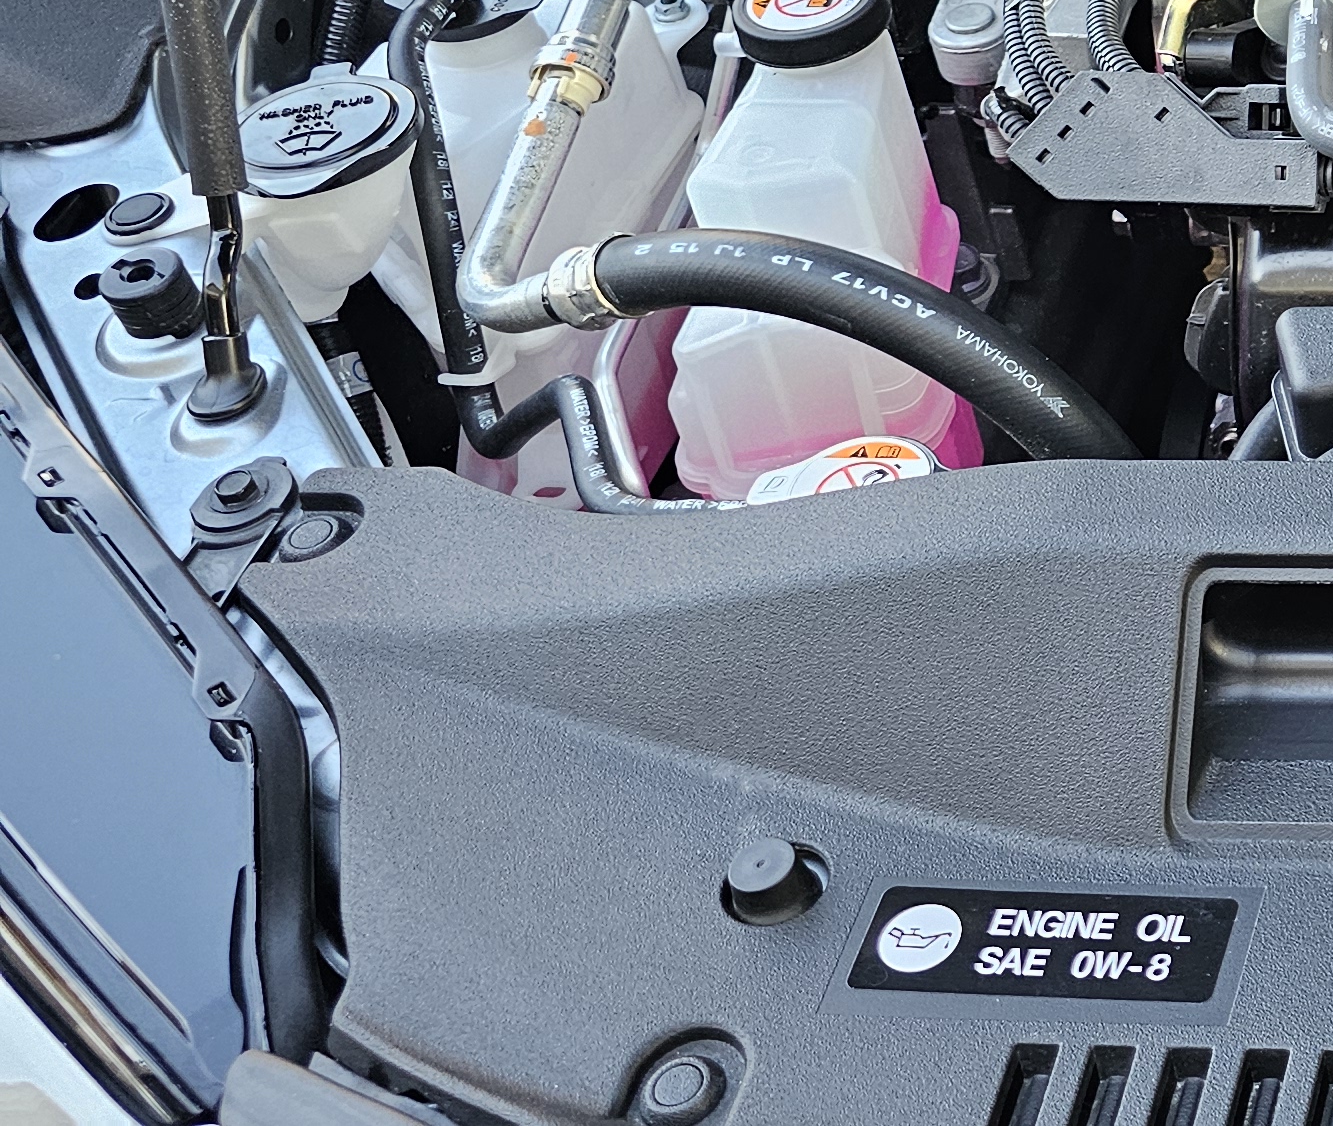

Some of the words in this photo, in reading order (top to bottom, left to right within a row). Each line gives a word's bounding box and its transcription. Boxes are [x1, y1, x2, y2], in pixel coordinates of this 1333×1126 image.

[258, 103, 322, 121] WASHER
[295, 109, 334, 123] ONLY
[633, 243, 654, 256] 2
[668, 241, 700, 254] 15
[713, 244, 747, 258] 1J
[770, 253, 816, 273] LP
[830, 271, 938, 319] ACV17
[956, 324, 1044, 397] YOKOHAMA
[570, 387, 592, 423] WATER
[652, 499, 704, 510] WATER
[986, 908, 1120, 941] ENGINE
[1136, 913, 1192, 943] OIL
[973, 946, 1052, 977] SAE
[1070, 950, 1172, 982] 0W-8
